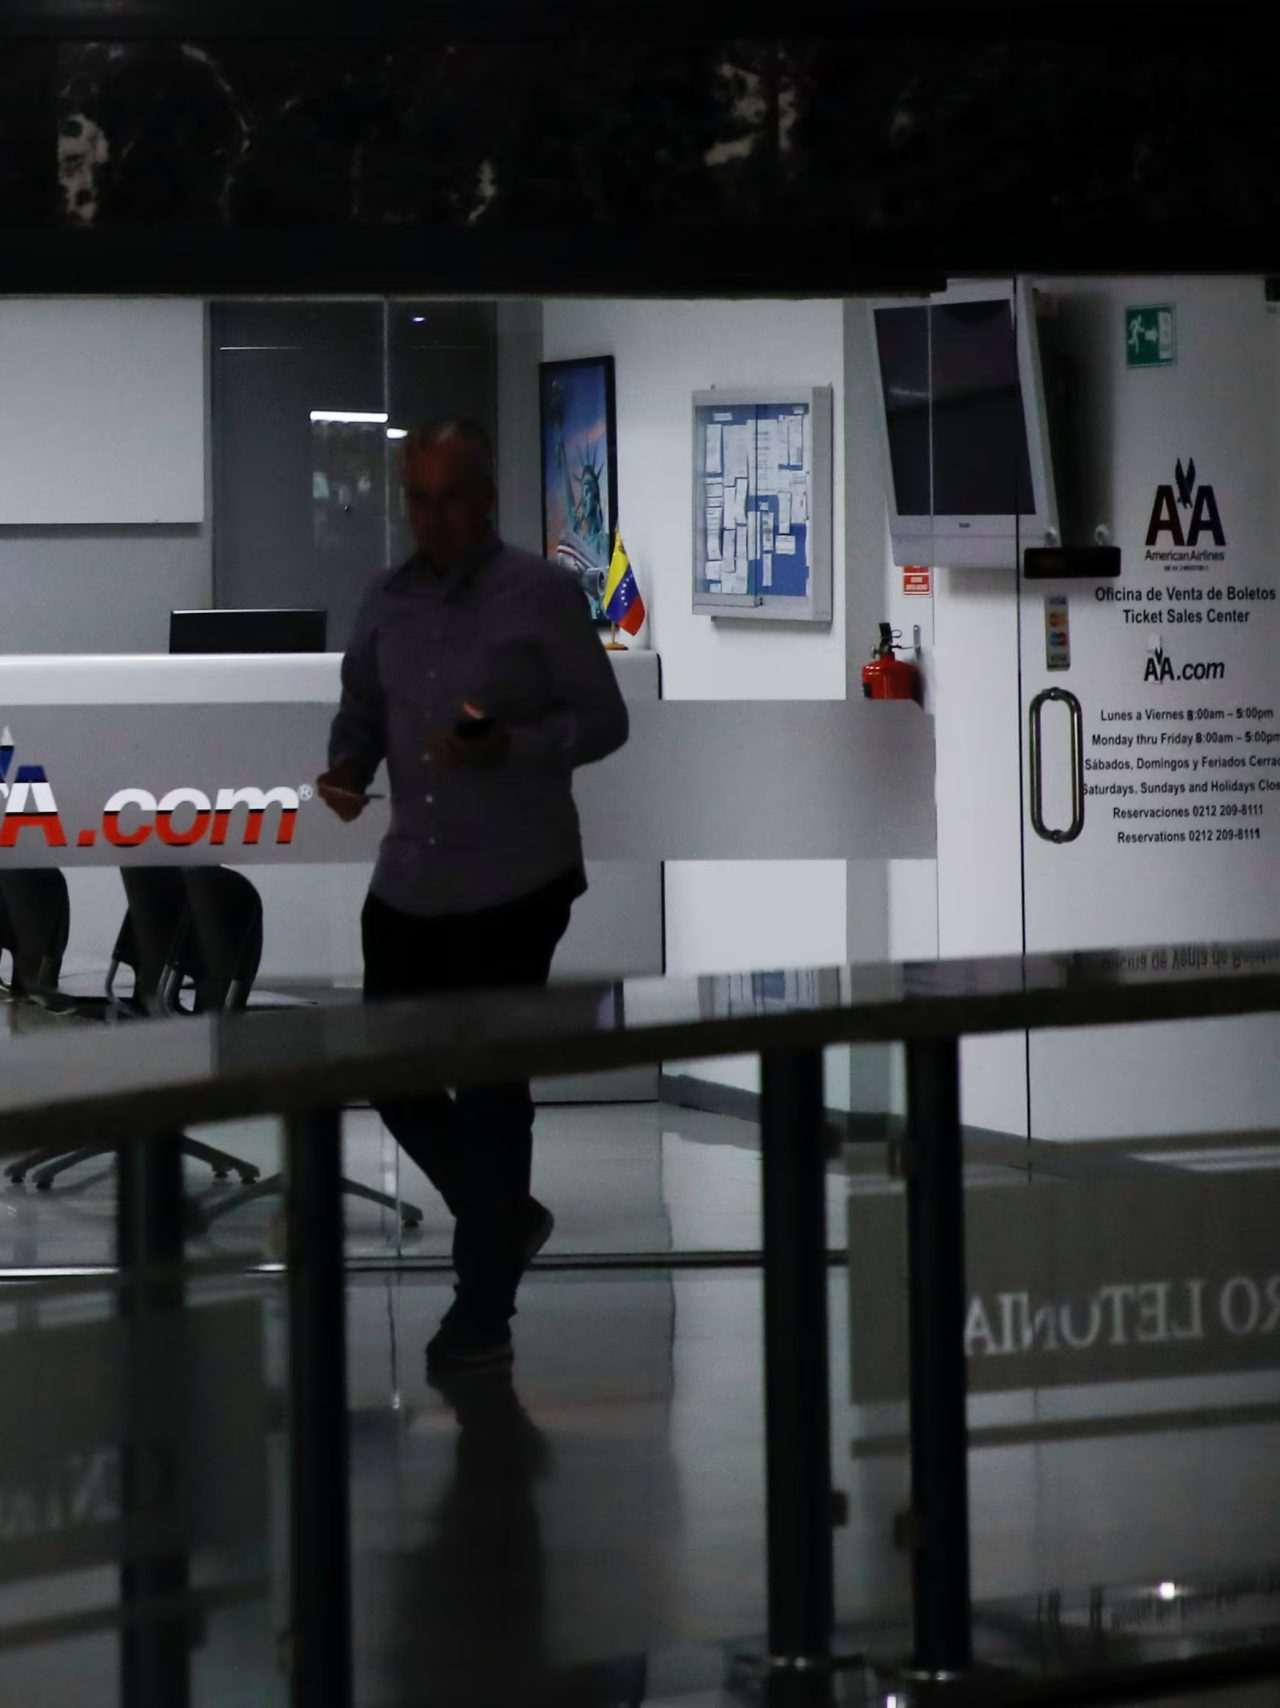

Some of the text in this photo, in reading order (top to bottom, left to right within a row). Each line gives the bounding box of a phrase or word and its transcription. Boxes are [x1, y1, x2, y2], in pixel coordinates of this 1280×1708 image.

[1144, 484, 1227, 547] AA
[1145, 549, 1225, 561] American Airlines
[1095, 585, 1276, 601] Oficina de Venta de Boletos
[1123, 608, 1250, 624] Ticket Sales Center
[1100, 709, 1133, 721] Lunes
[1135, 711, 1142, 720] a
[1145, 709, 1184, 721] Viernes
[1187, 708, 1225, 721] 8:00am
[1236, 707, 1274, 721] 5:00pm
[1092, 734, 1133, 748] Monday
[1136, 733, 1158, 745] thru
[1161, 732, 1193, 747] Friday
[1195, 731, 1233, 744] 8:00am
[1137, 757, 1189, 772] Domingos
[1192, 758, 1199, 771] y
[1202, 755, 1246, 768] Feriados
[1140, 781, 1185, 796] Sundays
[1188, 780, 1208, 793] and
[1211, 779, 1256, 795] Holidays
[1113, 803, 1264, 819] Reservaciones 0212 209-8111
[1117, 827, 1261, 844] Reservations 0212 209-8111
